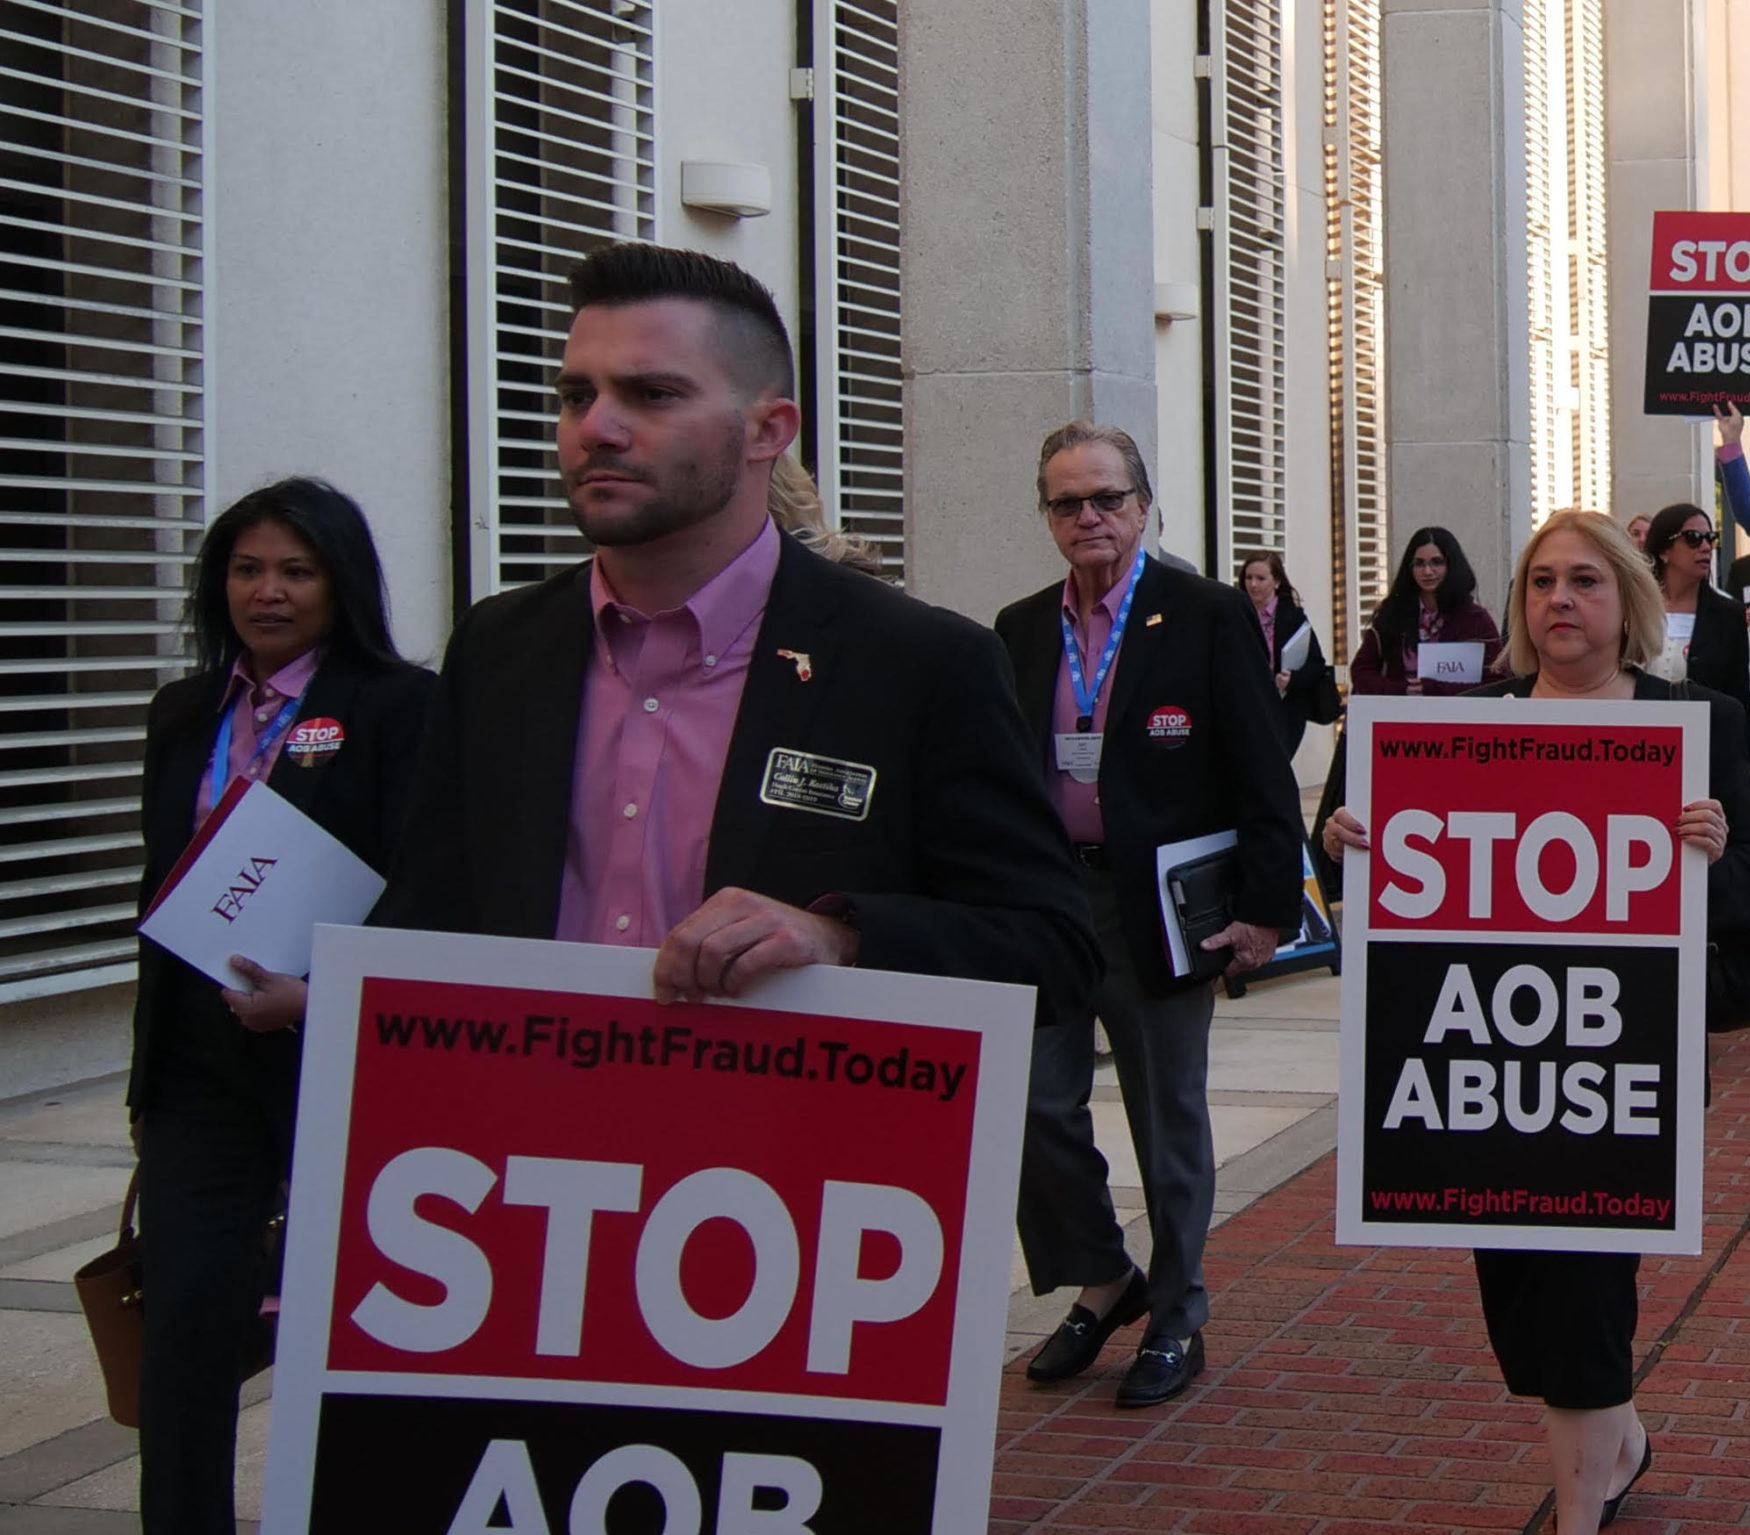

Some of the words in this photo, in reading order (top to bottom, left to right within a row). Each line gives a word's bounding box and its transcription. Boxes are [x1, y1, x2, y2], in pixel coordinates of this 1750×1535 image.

[1437, 661, 1465, 674] FAIA
[296, 726, 340, 741] STOP
[1153, 714, 1186, 726] STOP
[288, 744, 310, 753] AOB
[310, 742, 340, 752] ABUSE
[776, 754, 809, 773] FAIA
[1379, 736, 1677, 767] www.FightFraud.Today
[1378, 808, 1674, 922] STOP
[210, 857, 278, 926] FAIA
[1423, 963, 1623, 1047] AOB
[375, 1012, 968, 1101] www.FightFraud.Today
[1382, 1058, 1660, 1135] ABUSE
[1370, 1187, 1673, 1221] www.FightFraud.Today
[350, 1146, 945, 1376] STOP
[446, 1438, 823, 1535] AOB
